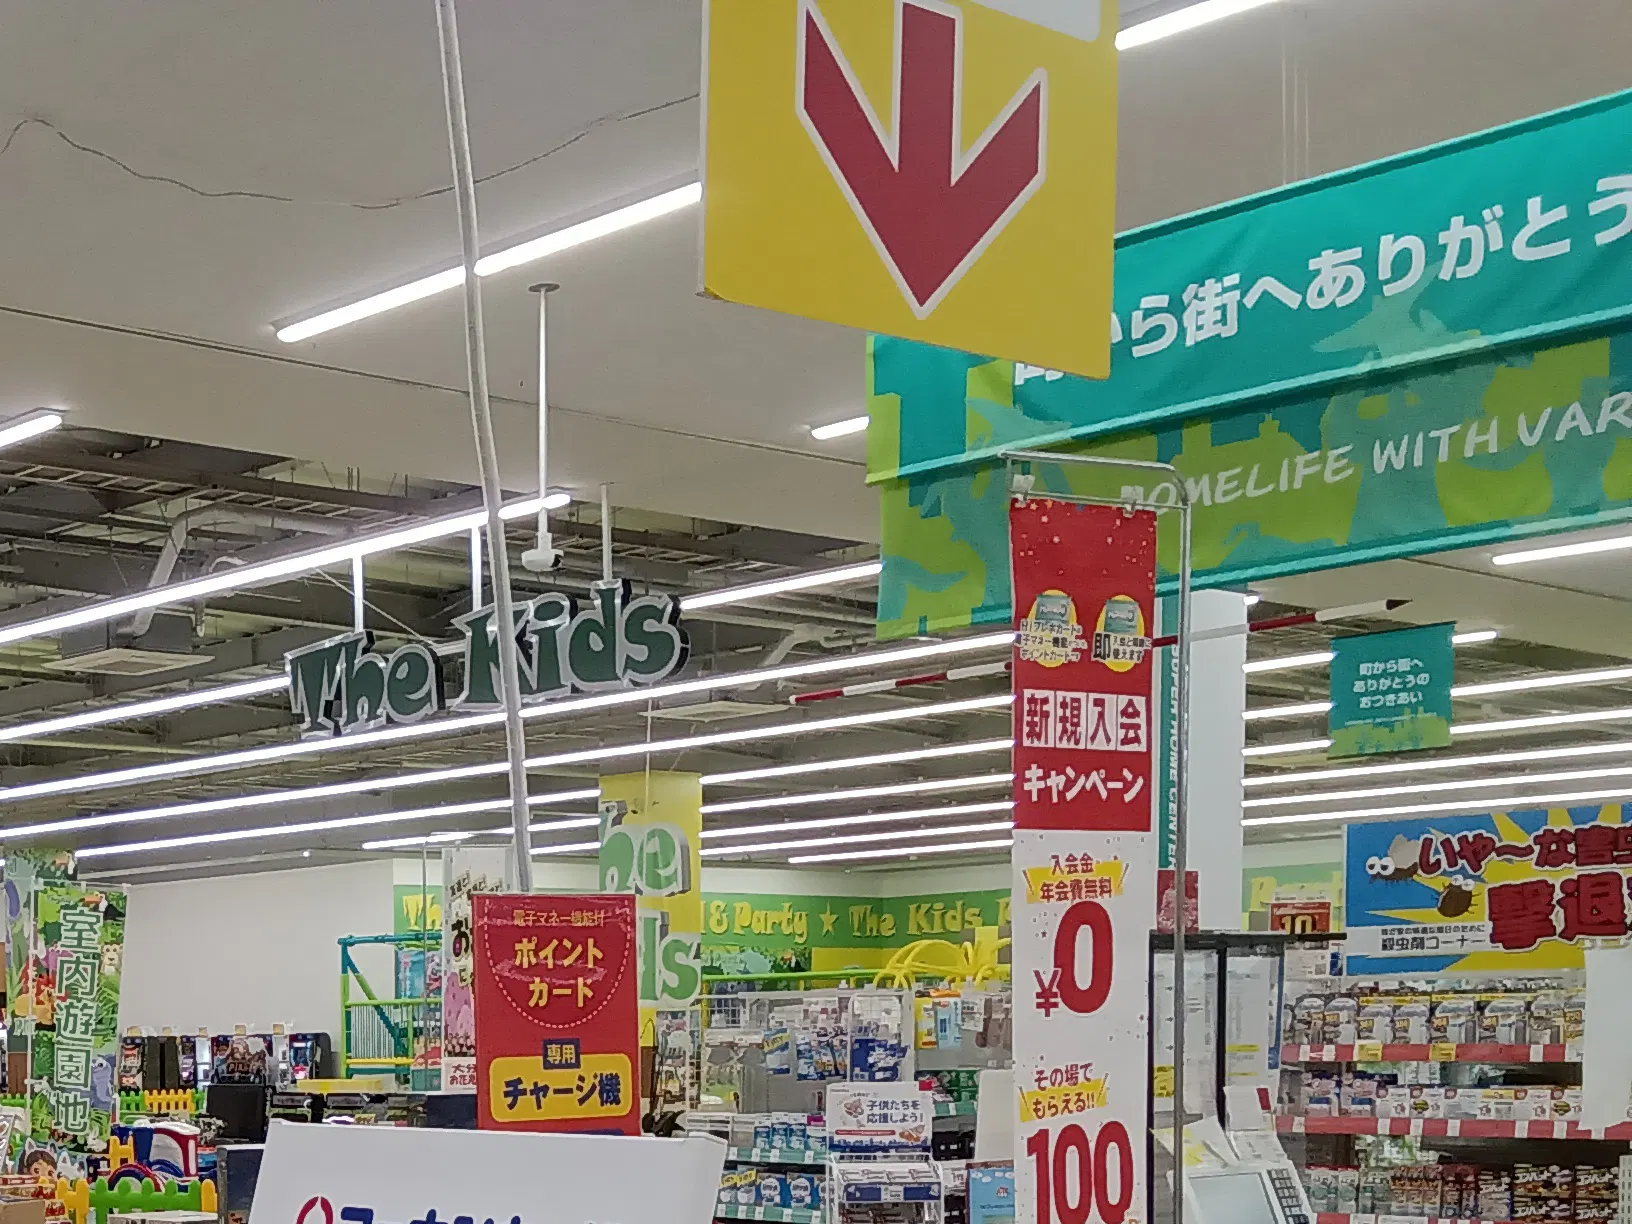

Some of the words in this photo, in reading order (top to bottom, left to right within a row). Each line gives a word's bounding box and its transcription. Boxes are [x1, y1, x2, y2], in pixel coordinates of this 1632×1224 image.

[1111, 175, 1632, 358] ら街へありがとう
[1372, 415, 1502, 474] WITH
[284, 630, 442, 738] The
[451, 578, 690, 712] Kids
[1093, 633, 1111, 660] 即
[1025, 695, 1143, 747] 新規入会
[1023, 763, 1144, 803] キャンペーン
[1051, 852, 1094, 875] 入会金
[1039, 877, 1113, 903] 年会費無料
[402, 894, 443, 931] Th
[734, 900, 809, 944] Party
[849, 904, 896, 938] The
[907, 900, 984, 936] Kids
[514, 936, 604, 969] ポイント
[528, 976, 595, 1008] カード
[52, 905, 103, 1135] 室内遊園地
[546, 1042, 577, 1065] 専用
[503, 1071, 622, 1111] チャージ機
[1033, 1062, 1093, 1090] その場で
[866, 1099, 921, 1111] 子供たちを
[1032, 1092, 1097, 1121] もらえる!!
